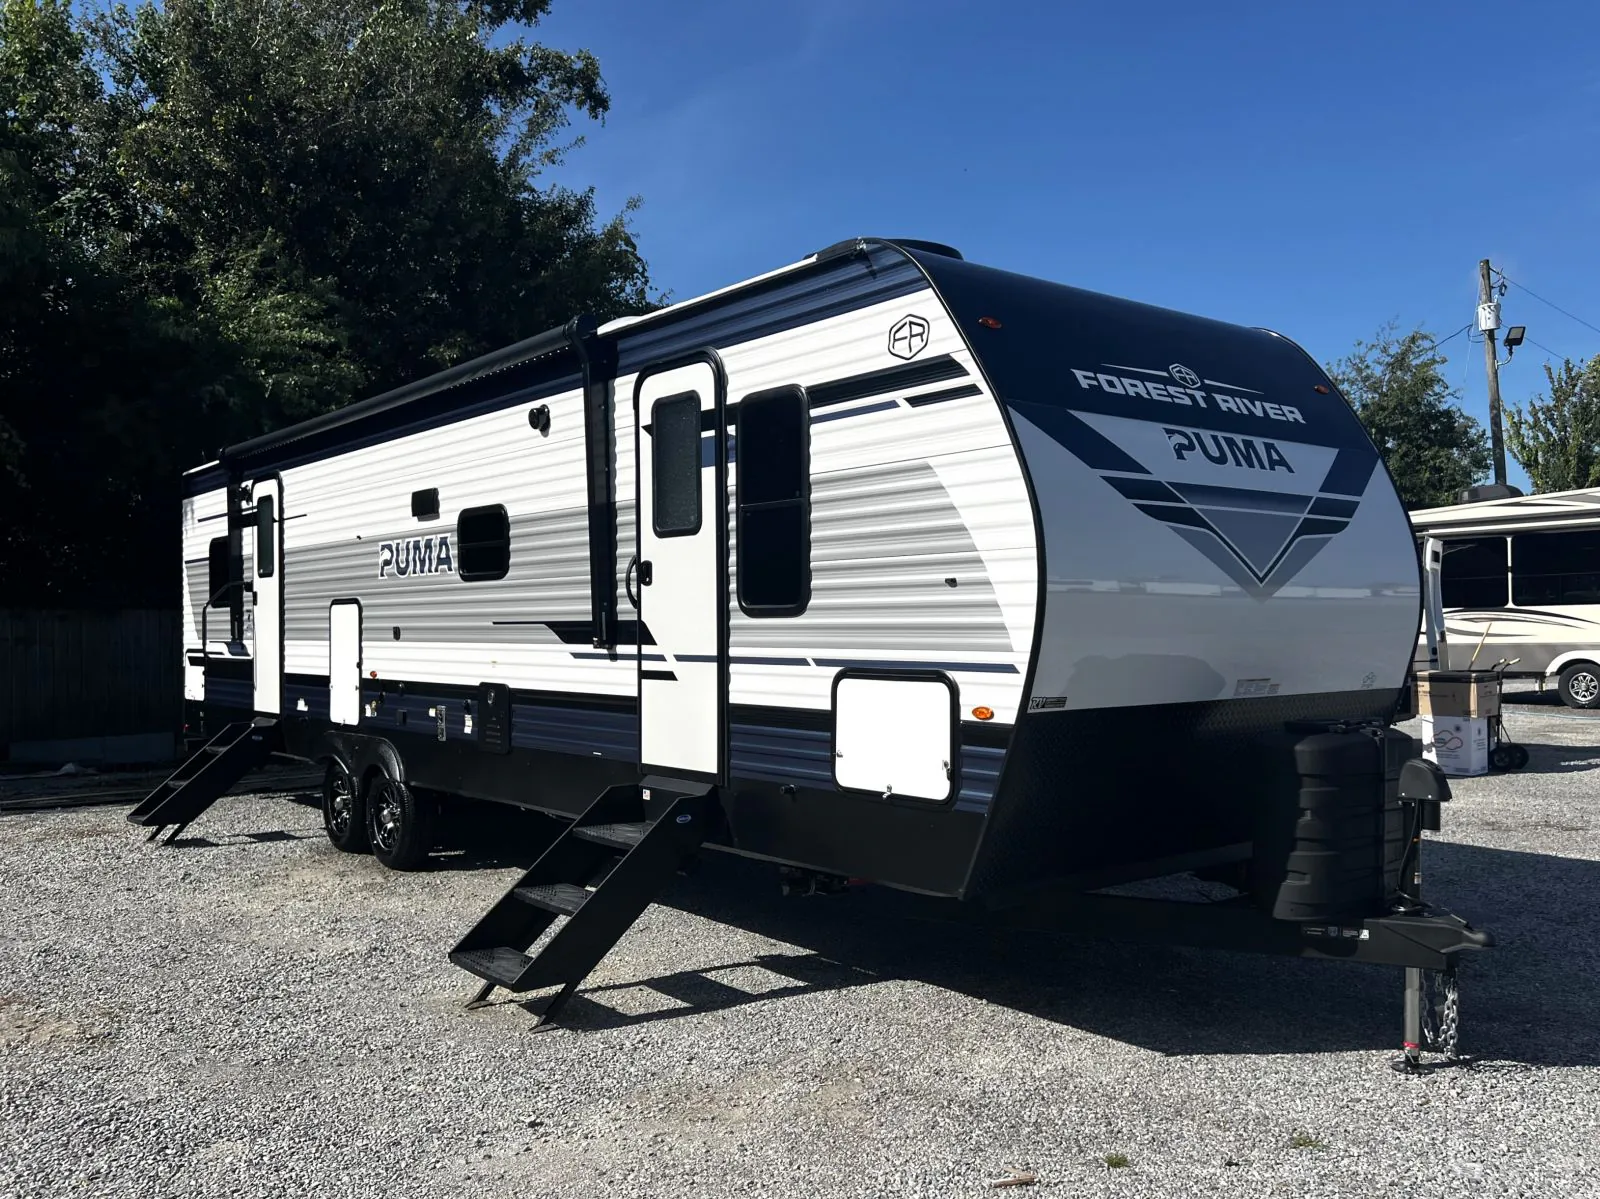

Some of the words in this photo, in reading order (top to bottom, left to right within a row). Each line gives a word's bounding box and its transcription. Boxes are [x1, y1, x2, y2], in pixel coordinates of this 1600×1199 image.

[1070, 368, 1207, 409] FOREST
[1211, 394, 1306, 424] RIVER
[1162, 427, 1296, 474] PUMA
[378, 533, 454, 579] PUMA
